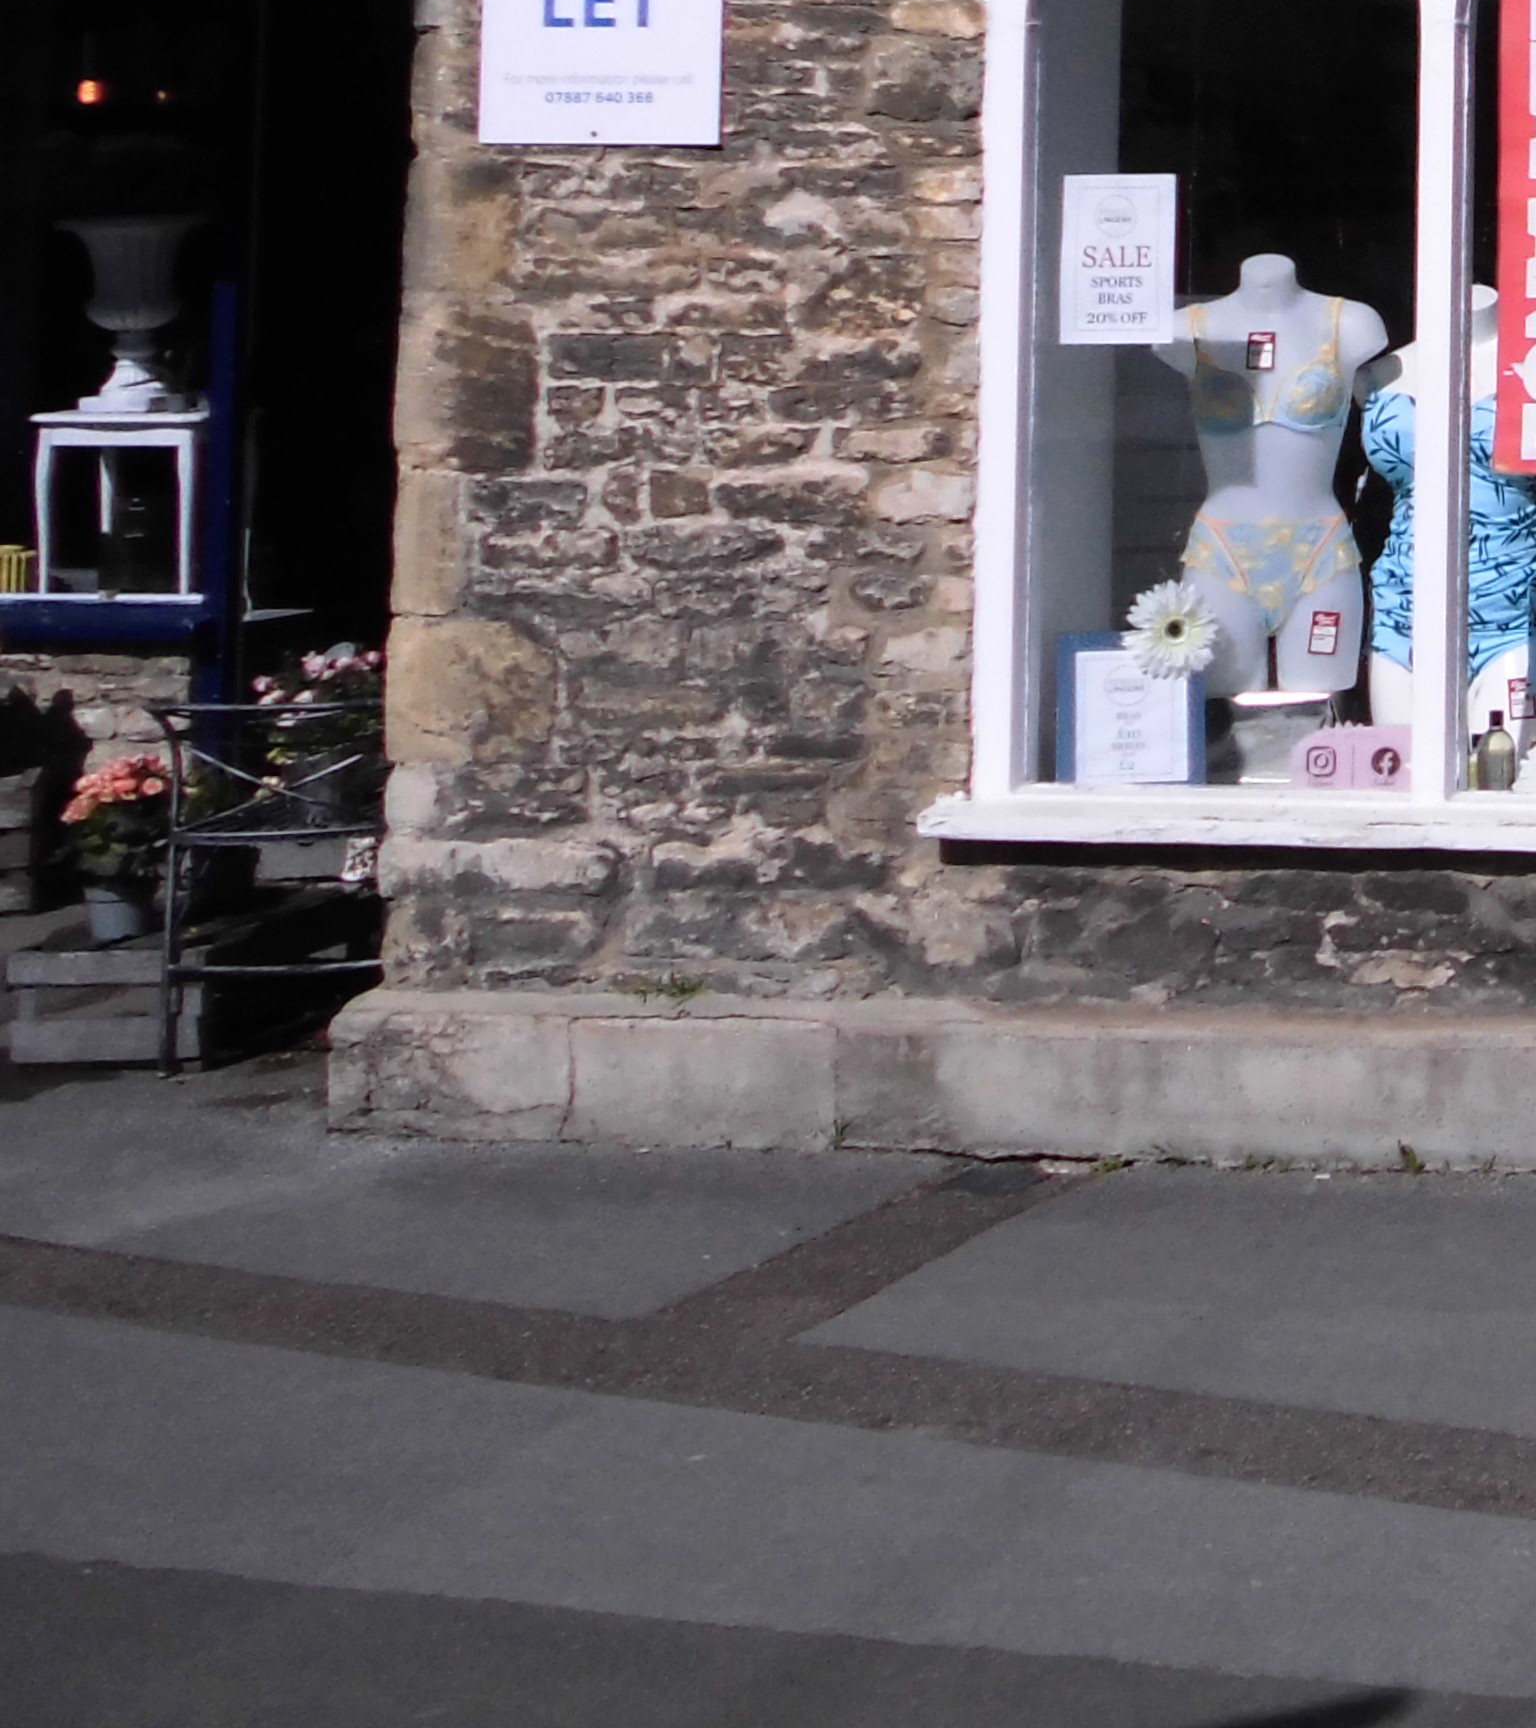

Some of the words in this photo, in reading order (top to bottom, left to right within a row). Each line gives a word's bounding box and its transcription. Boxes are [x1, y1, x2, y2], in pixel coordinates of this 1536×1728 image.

[1081, 245, 1152, 269] SALE
[1090, 276, 1143, 288] SPORTS
[1098, 293, 1132, 305] BRAS
[1086, 313, 1117, 324] 20%
[1120, 312, 1148, 324] OFF
